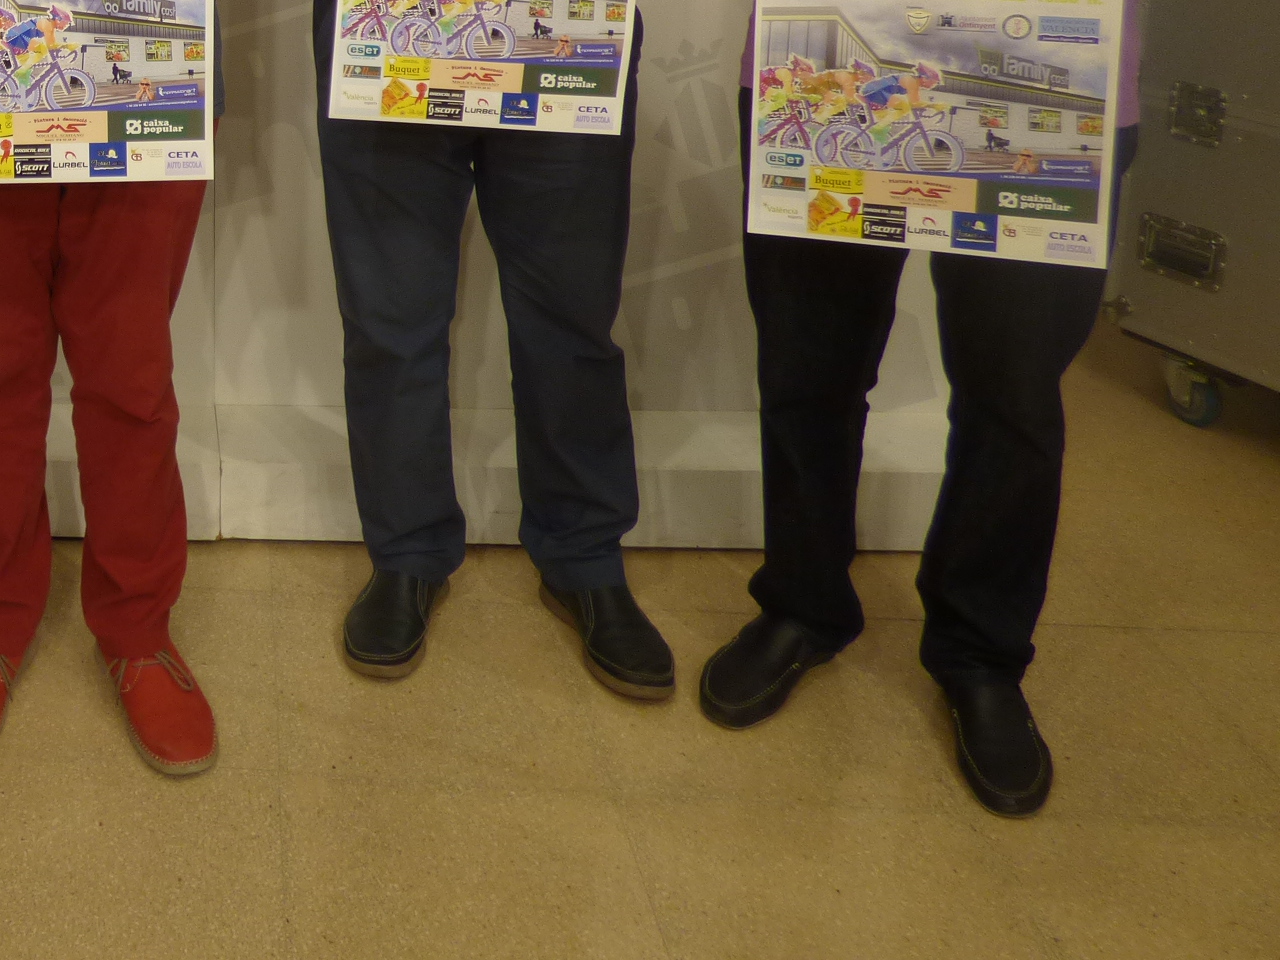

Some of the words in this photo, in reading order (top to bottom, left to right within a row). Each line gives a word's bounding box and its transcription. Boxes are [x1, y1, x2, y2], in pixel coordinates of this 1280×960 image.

[578, 106, 608, 114] CETA
[143, 119, 169, 127] caixa
[143, 125, 184, 134] popular
